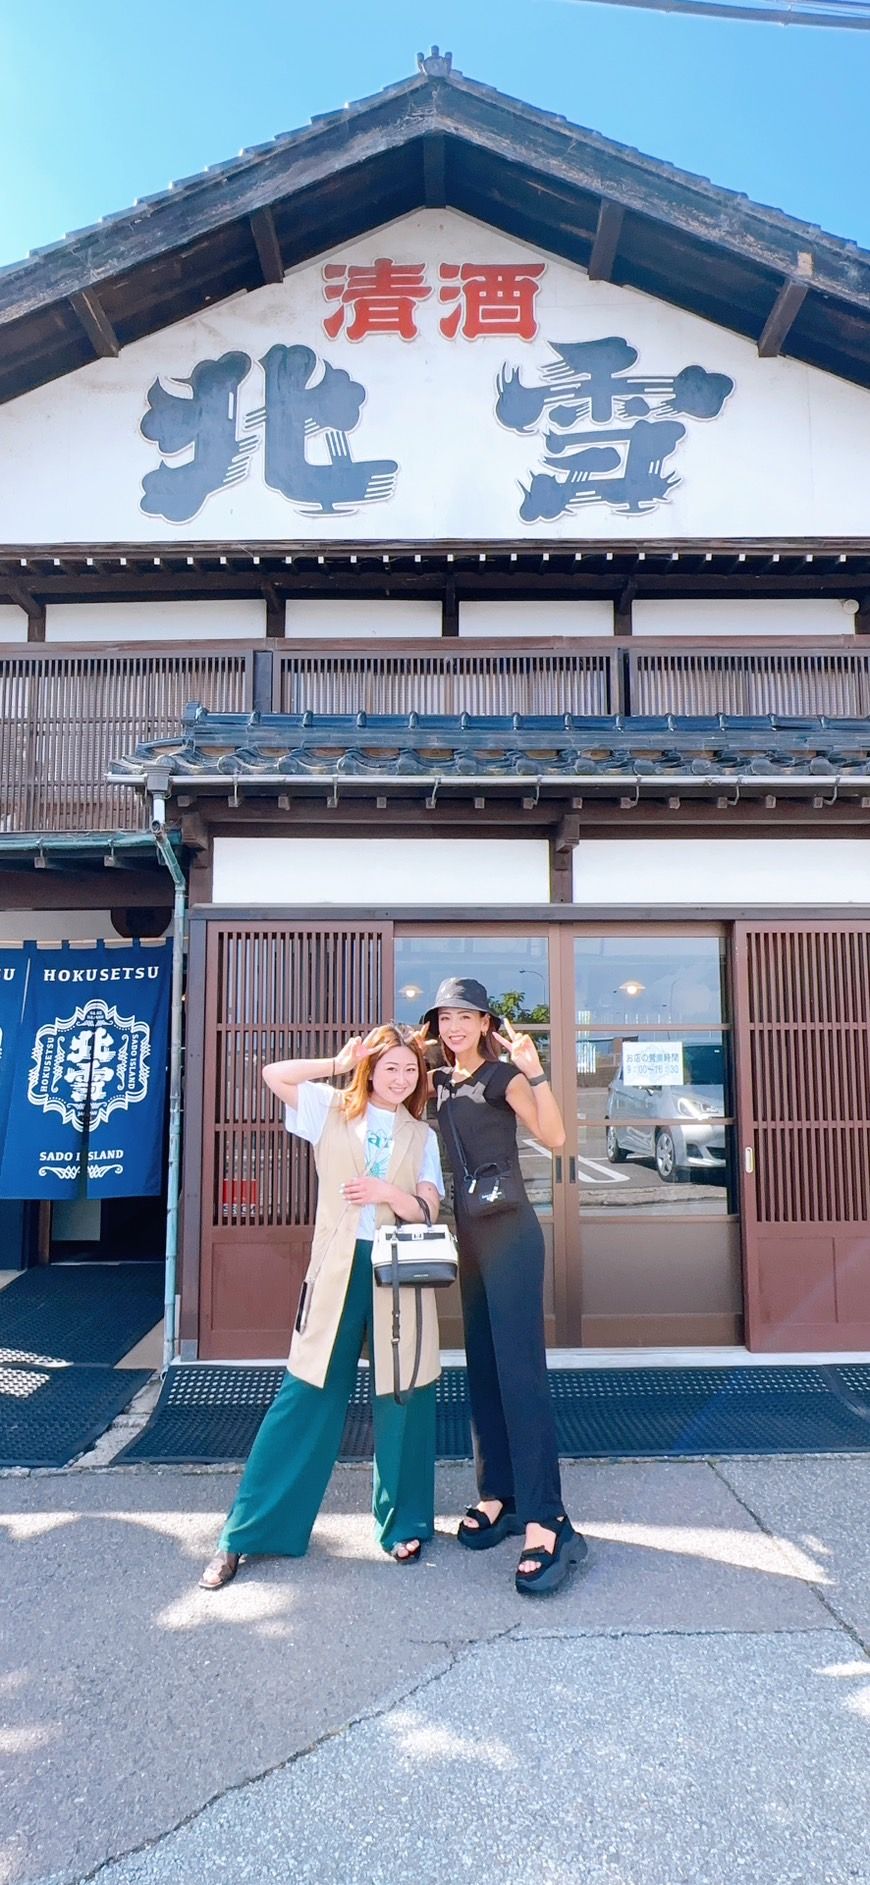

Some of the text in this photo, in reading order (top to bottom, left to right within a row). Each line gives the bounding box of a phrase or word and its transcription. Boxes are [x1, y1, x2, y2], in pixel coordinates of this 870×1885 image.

[320, 257, 548, 342] 清酒
[139, 334, 735, 524] 北雪
[43, 966, 160, 982] HOKUSETSU
[40, 1037, 55, 1093] HOKUSETSU
[127, 1033, 140, 1090] SADO ISLAND
[39, 1149, 124, 1162] SADO ISLAND
